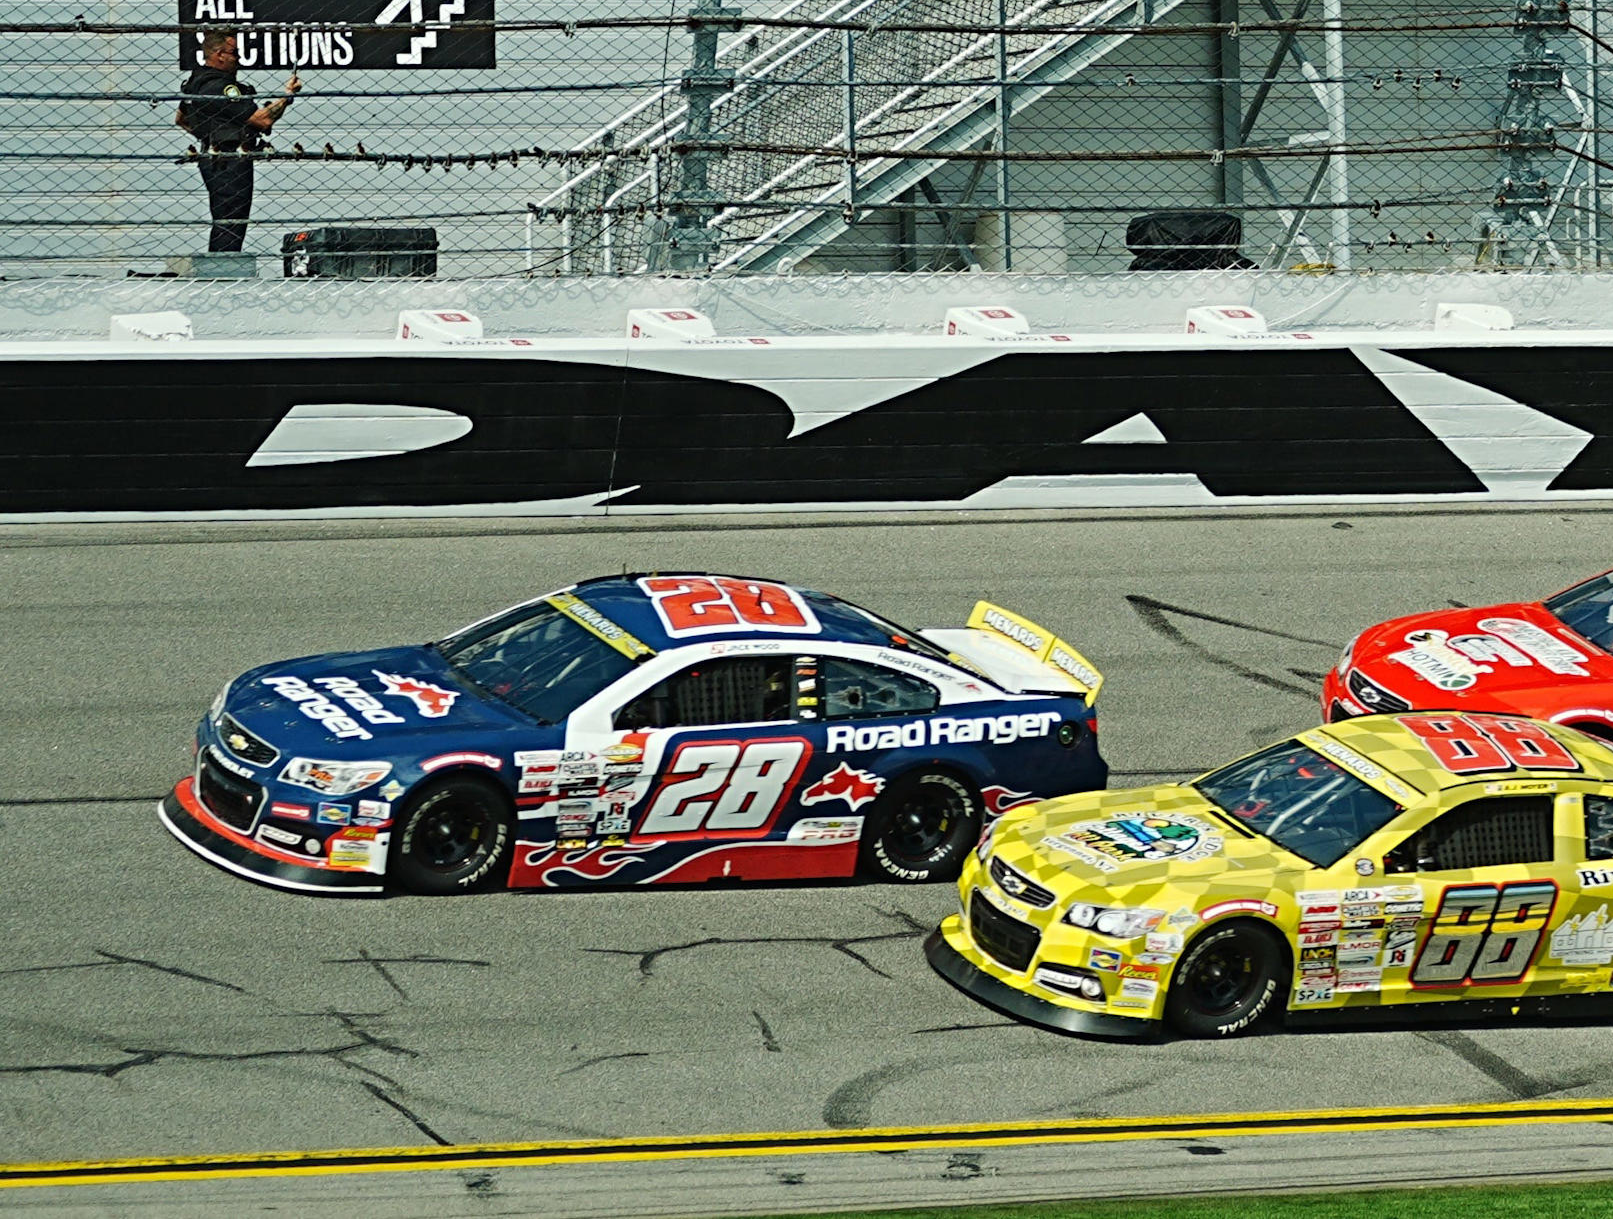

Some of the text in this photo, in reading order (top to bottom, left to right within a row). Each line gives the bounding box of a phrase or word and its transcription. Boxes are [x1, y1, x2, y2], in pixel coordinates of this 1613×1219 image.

[195, 24, 354, 68] SCTIONS
[567, 580, 625, 642] MENARDS
[644, 577, 808, 632] 28
[984, 608, 1044, 652] MENARDS
[1051, 646, 1100, 691] MENARDS
[261, 675, 374, 741] Ranger
[312, 675, 406, 725] Road
[826, 710, 1063, 754] Road Ranger
[1396, 714, 1584, 775] 88
[560, 750, 585, 762] ARCA
[1321, 740, 1381, 779] MENARDS
[637, 739, 806, 837] 28
[873, 837, 930, 882] GENERAL
[1343, 890, 1370, 902] ARCA
[1414, 883, 1556, 986] 88
[1217, 979, 1278, 1036] GENERAL
